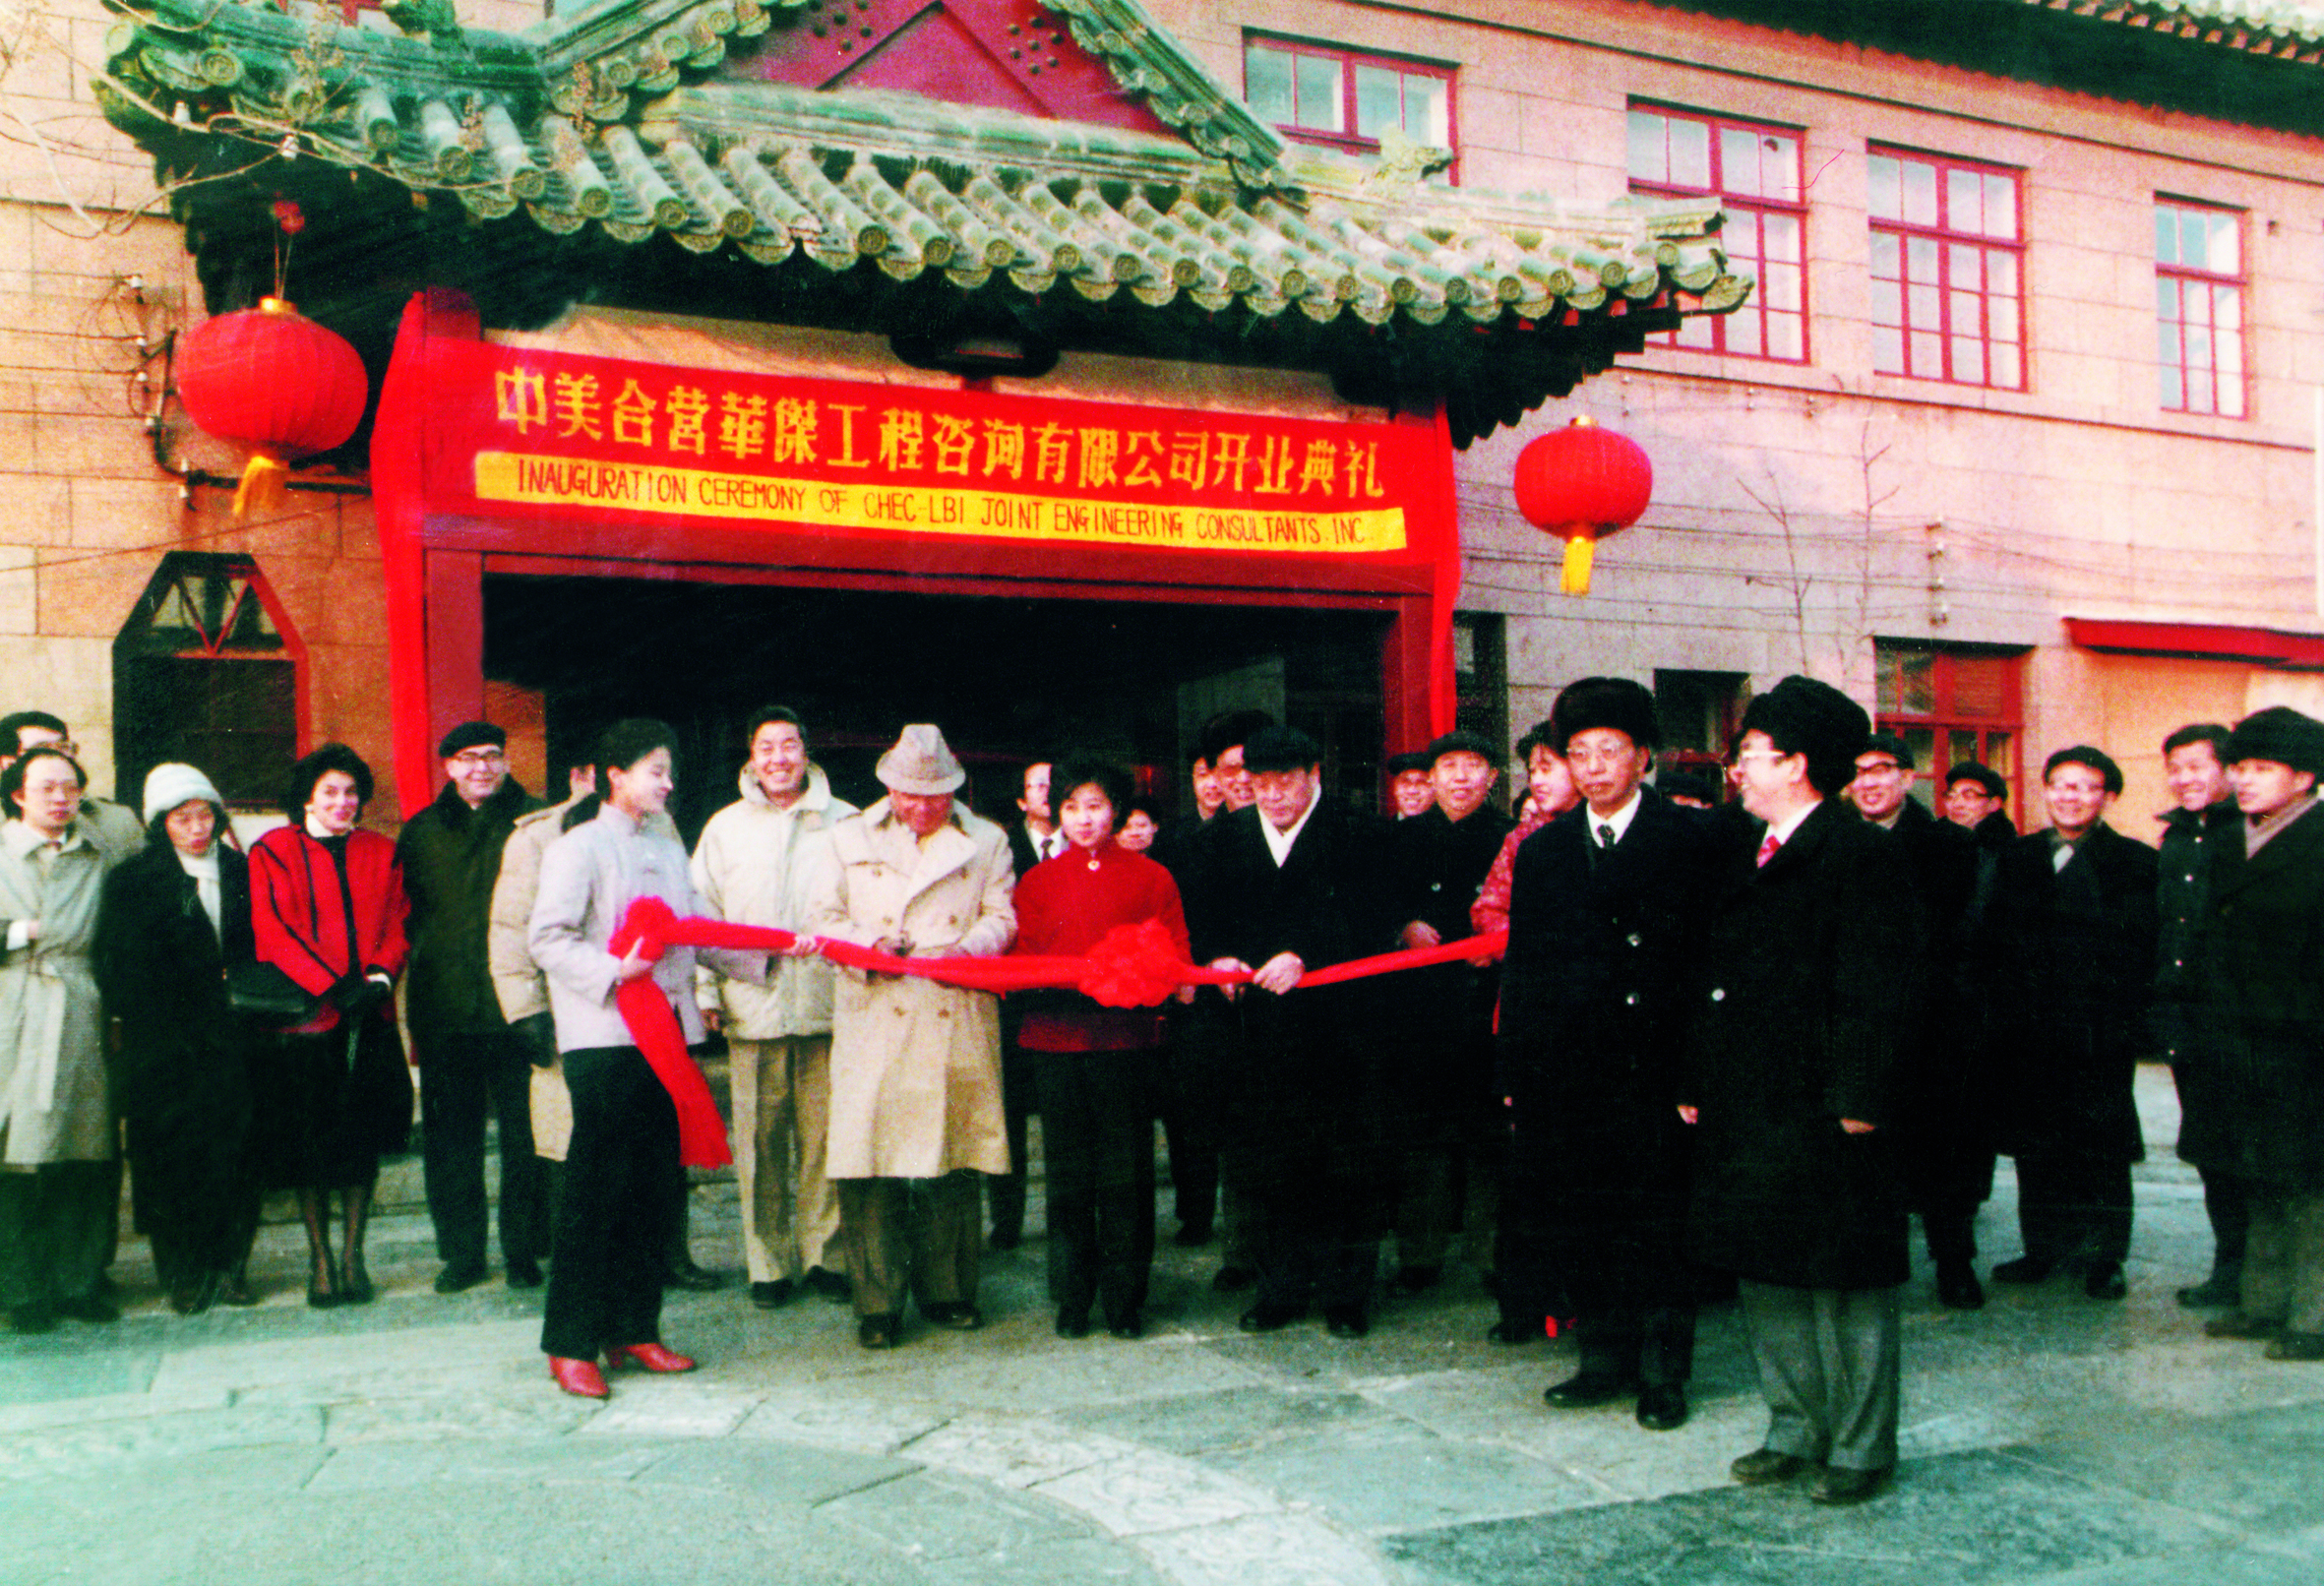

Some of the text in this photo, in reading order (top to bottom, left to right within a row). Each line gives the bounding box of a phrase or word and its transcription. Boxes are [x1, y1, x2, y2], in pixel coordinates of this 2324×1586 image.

[519, 458, 687, 505] INAUGURATION
[699, 476, 807, 512] CEREMONY
[819, 488, 848, 514] OF
[863, 491, 964, 524] CHEC-LBI
[981, 497, 1043, 531] JOINT
[1054, 503, 1184, 538] ENGINEERING
